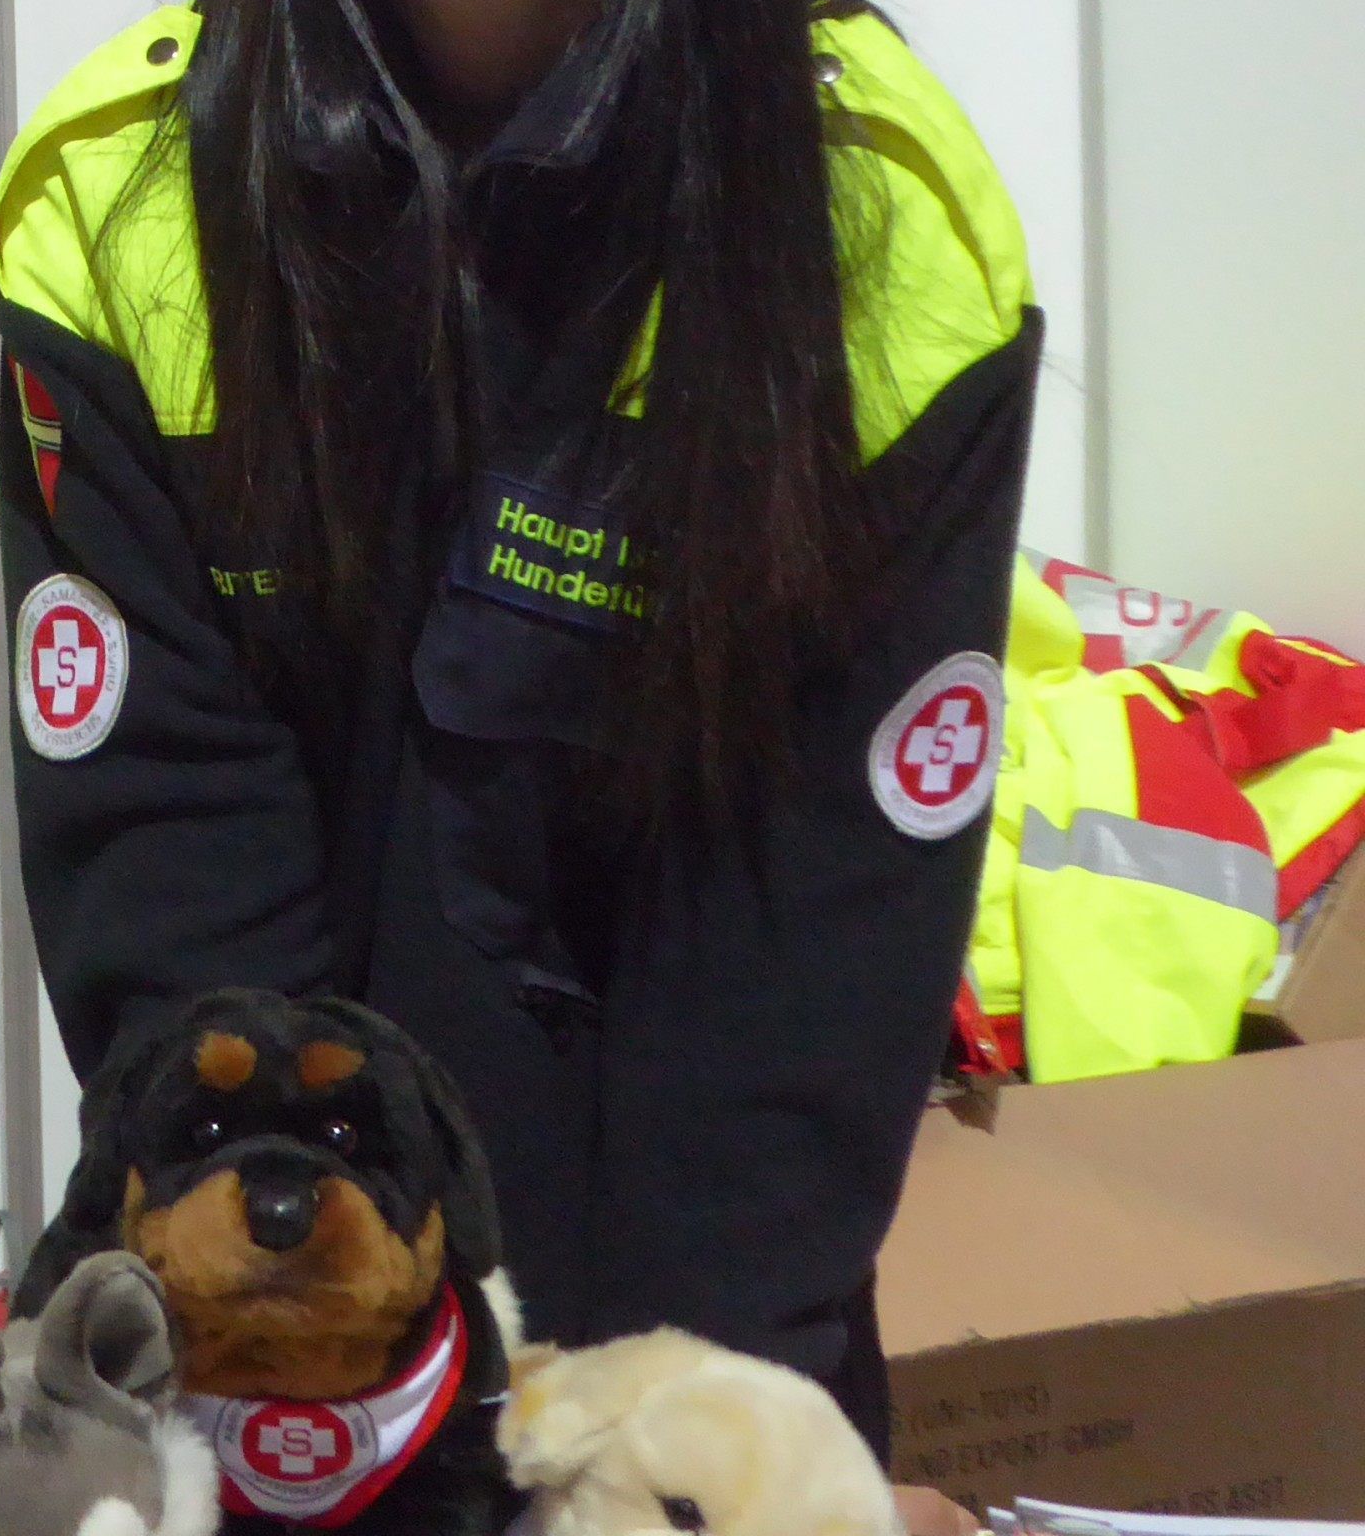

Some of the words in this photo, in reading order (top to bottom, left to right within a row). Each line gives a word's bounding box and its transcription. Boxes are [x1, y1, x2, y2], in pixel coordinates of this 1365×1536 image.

[497, 497, 605, 559] Haupt
[57, 646, 77, 688] S
[928, 723, 958, 766] S
[282, 1427, 312, 1457] S
